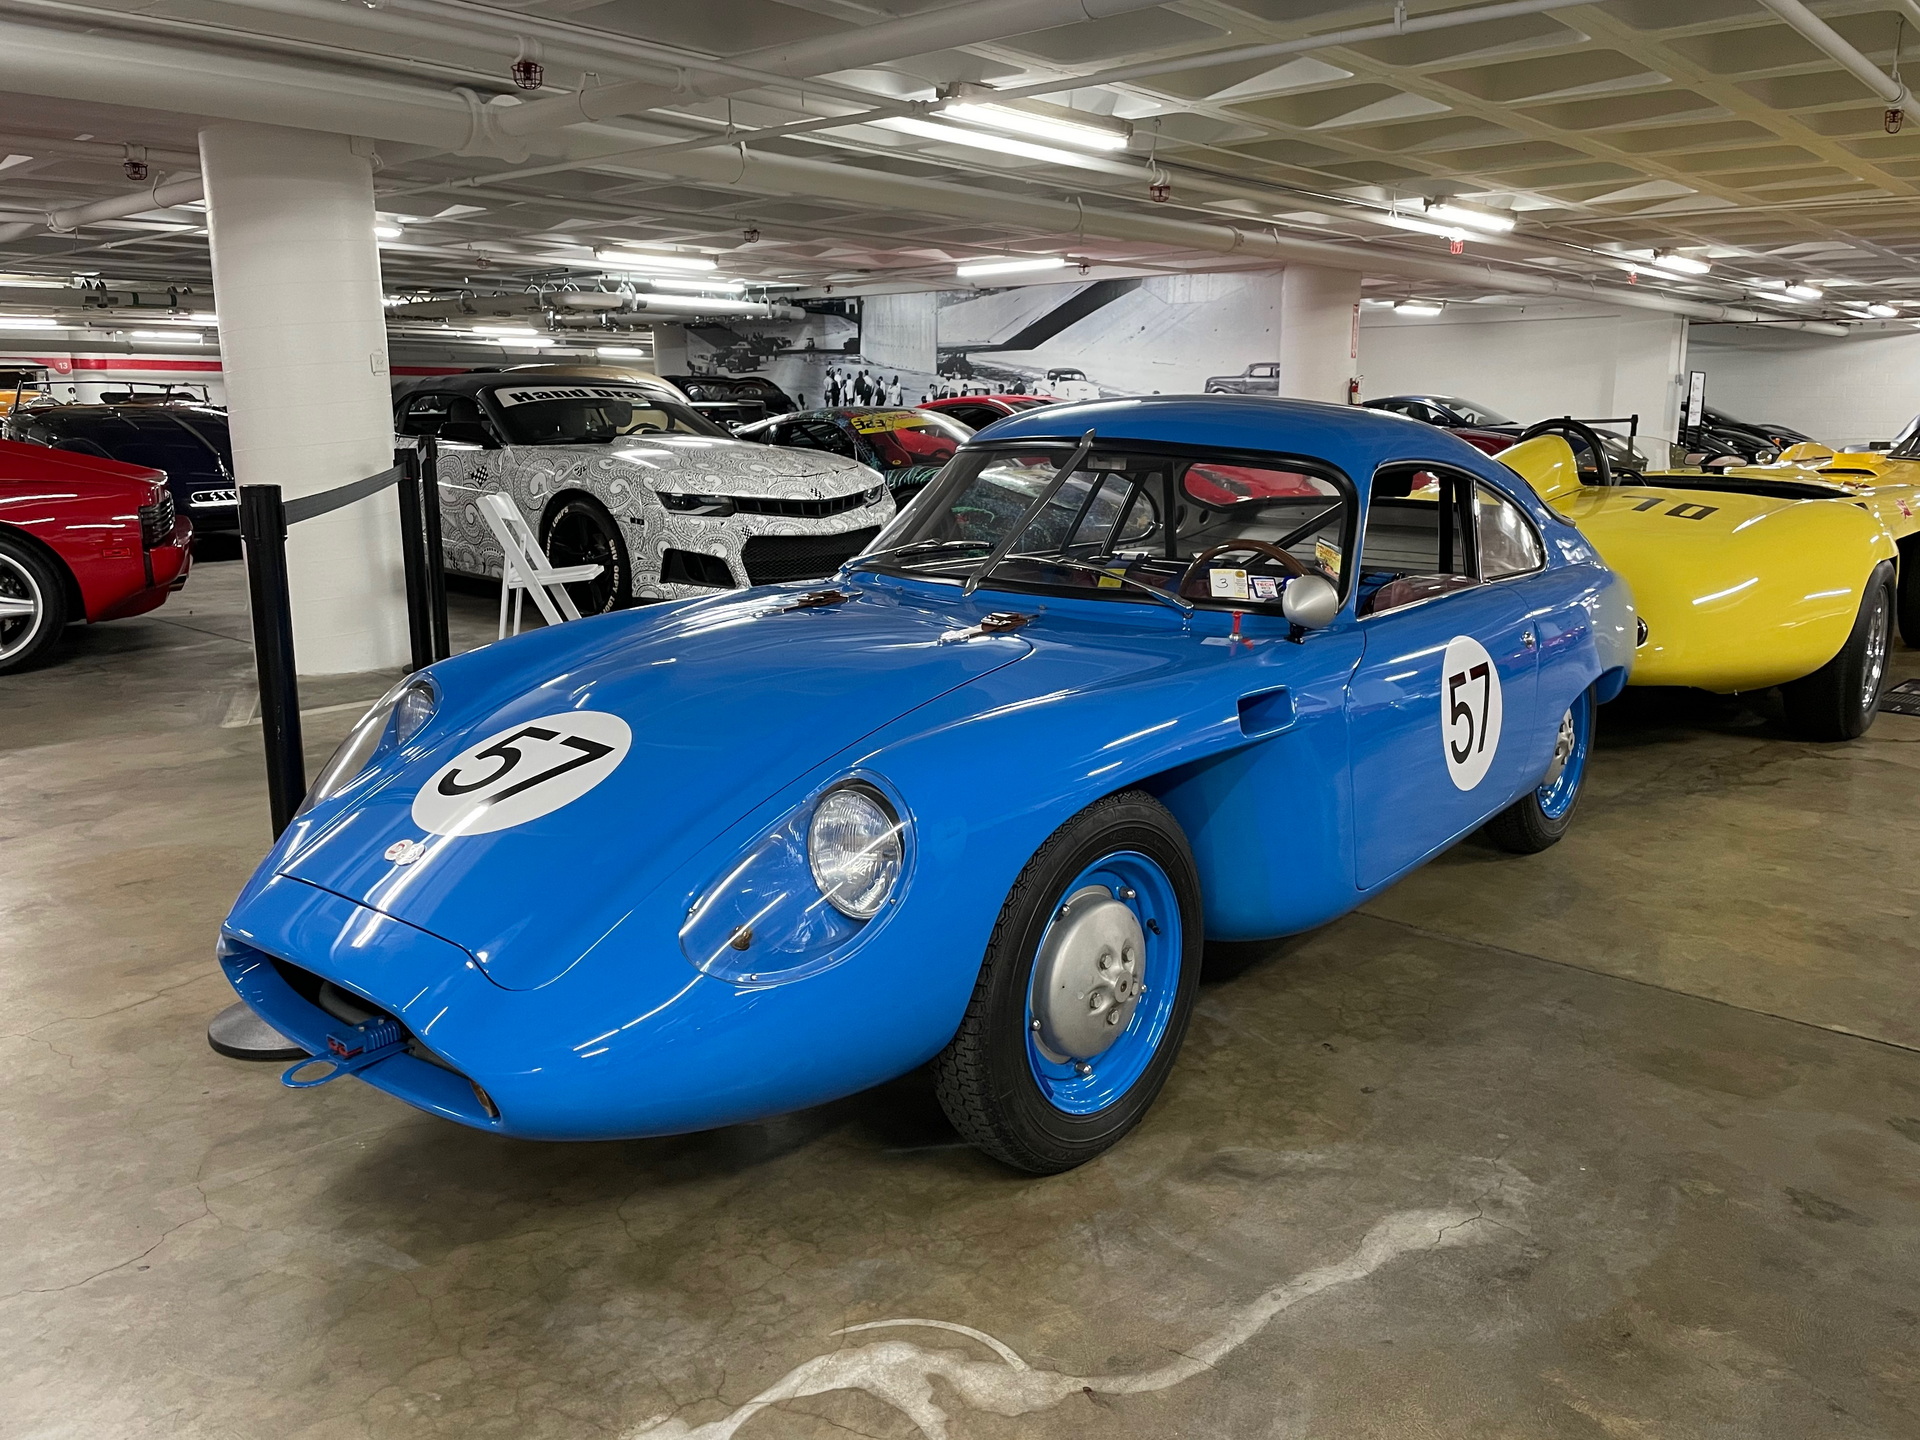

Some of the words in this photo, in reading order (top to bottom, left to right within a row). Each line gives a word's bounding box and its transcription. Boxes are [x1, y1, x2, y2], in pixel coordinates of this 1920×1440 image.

[58, 362, 68, 370] 13
[509, 388, 590, 403] Hand
[1215, 577, 1229, 589] 3
[1448, 661, 1491, 765] 57
[437, 726, 616, 807] 57
